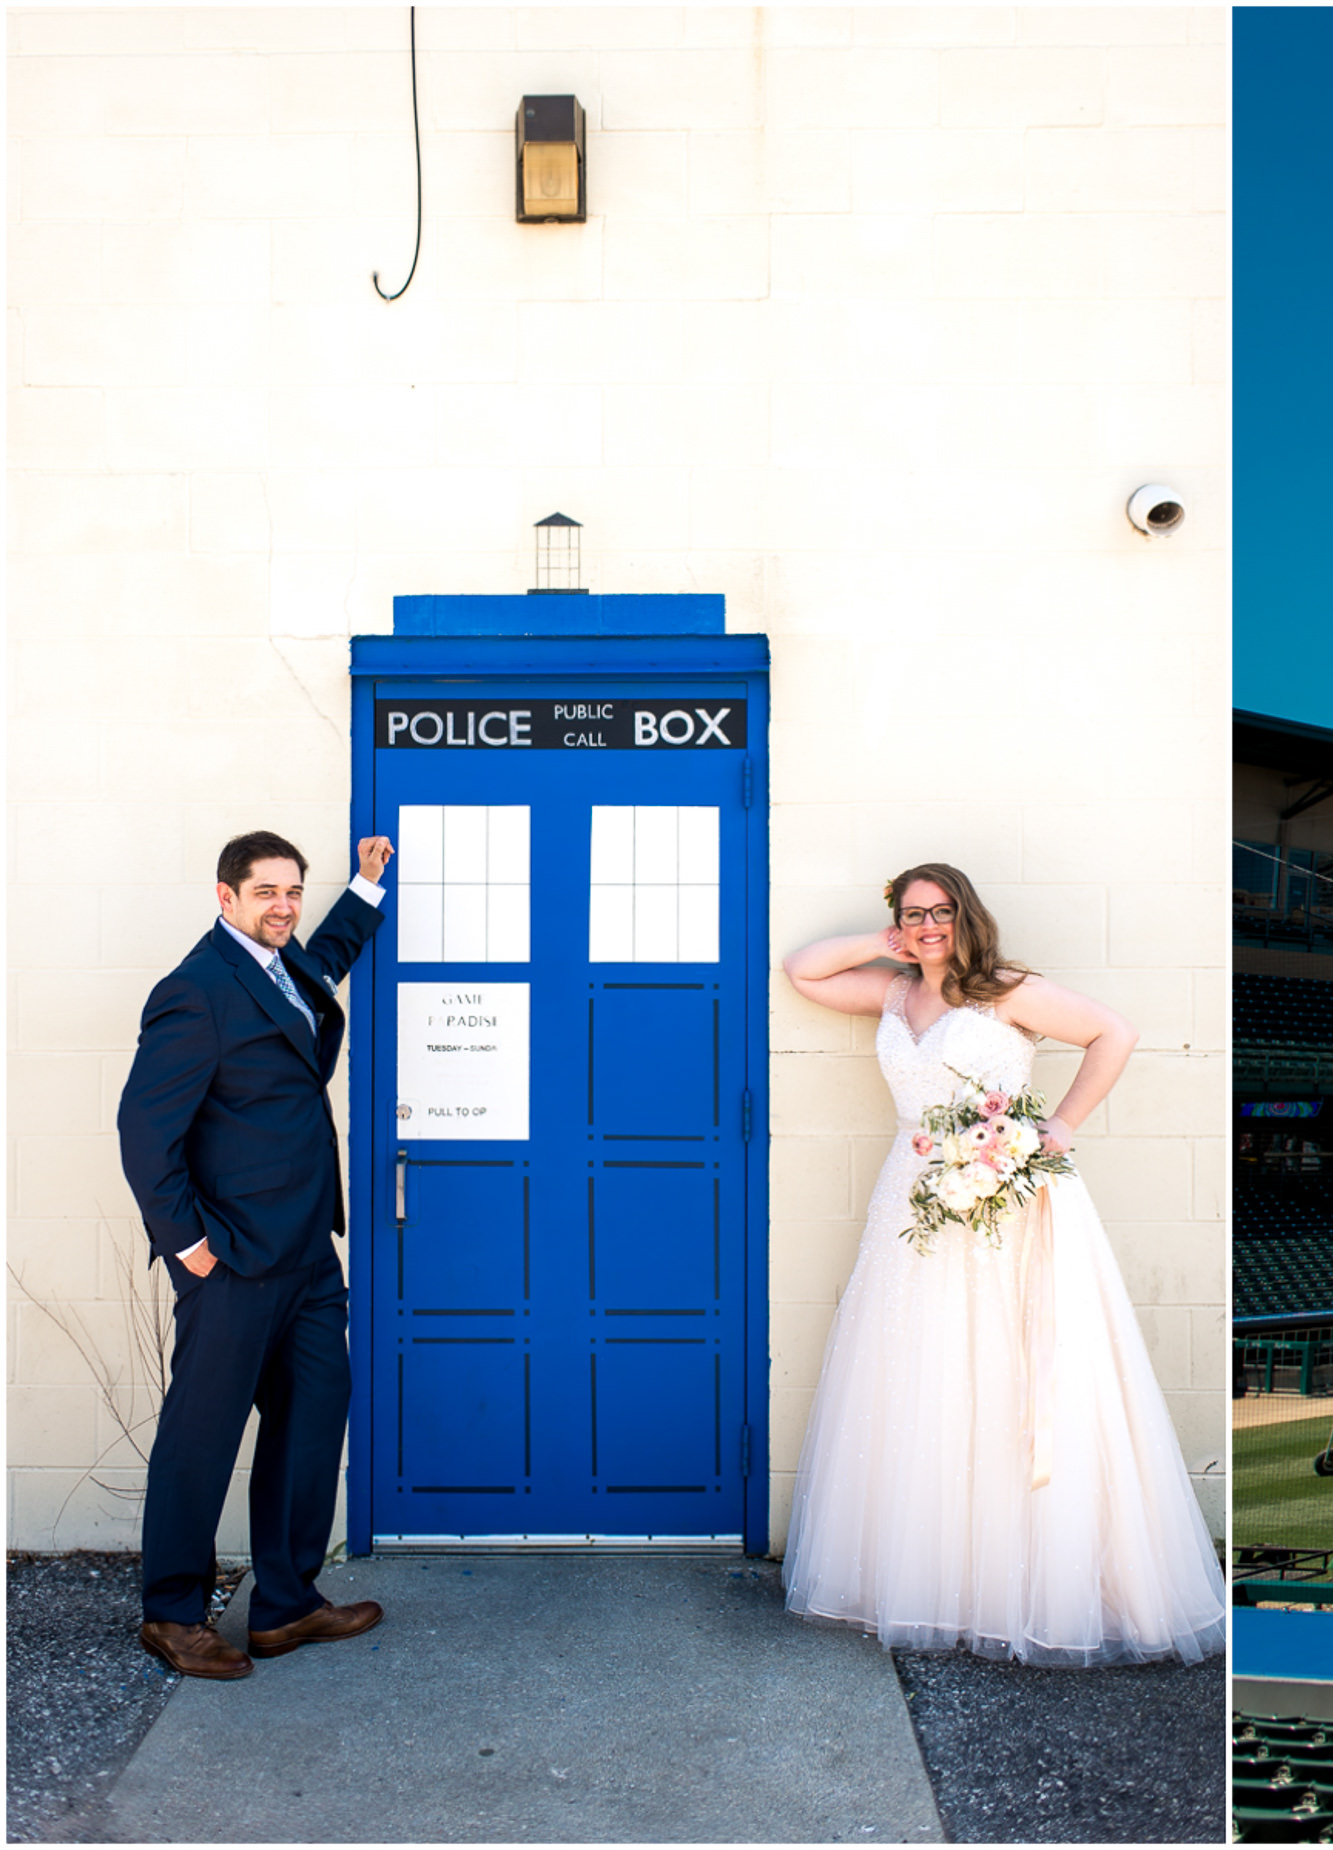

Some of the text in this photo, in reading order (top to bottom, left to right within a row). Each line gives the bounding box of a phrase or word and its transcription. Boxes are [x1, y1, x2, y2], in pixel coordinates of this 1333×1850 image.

[554, 704, 614, 720] PUBLIC
[388, 708, 732, 746] POLICE BOX
[563, 732, 607, 747] CALL
[427, 1015, 498, 1028] PRADISE
[426, 1044, 462, 1052] TUESDAY
[428, 1107, 453, 1117] PULL
[456, 1107, 470, 1117] TO
